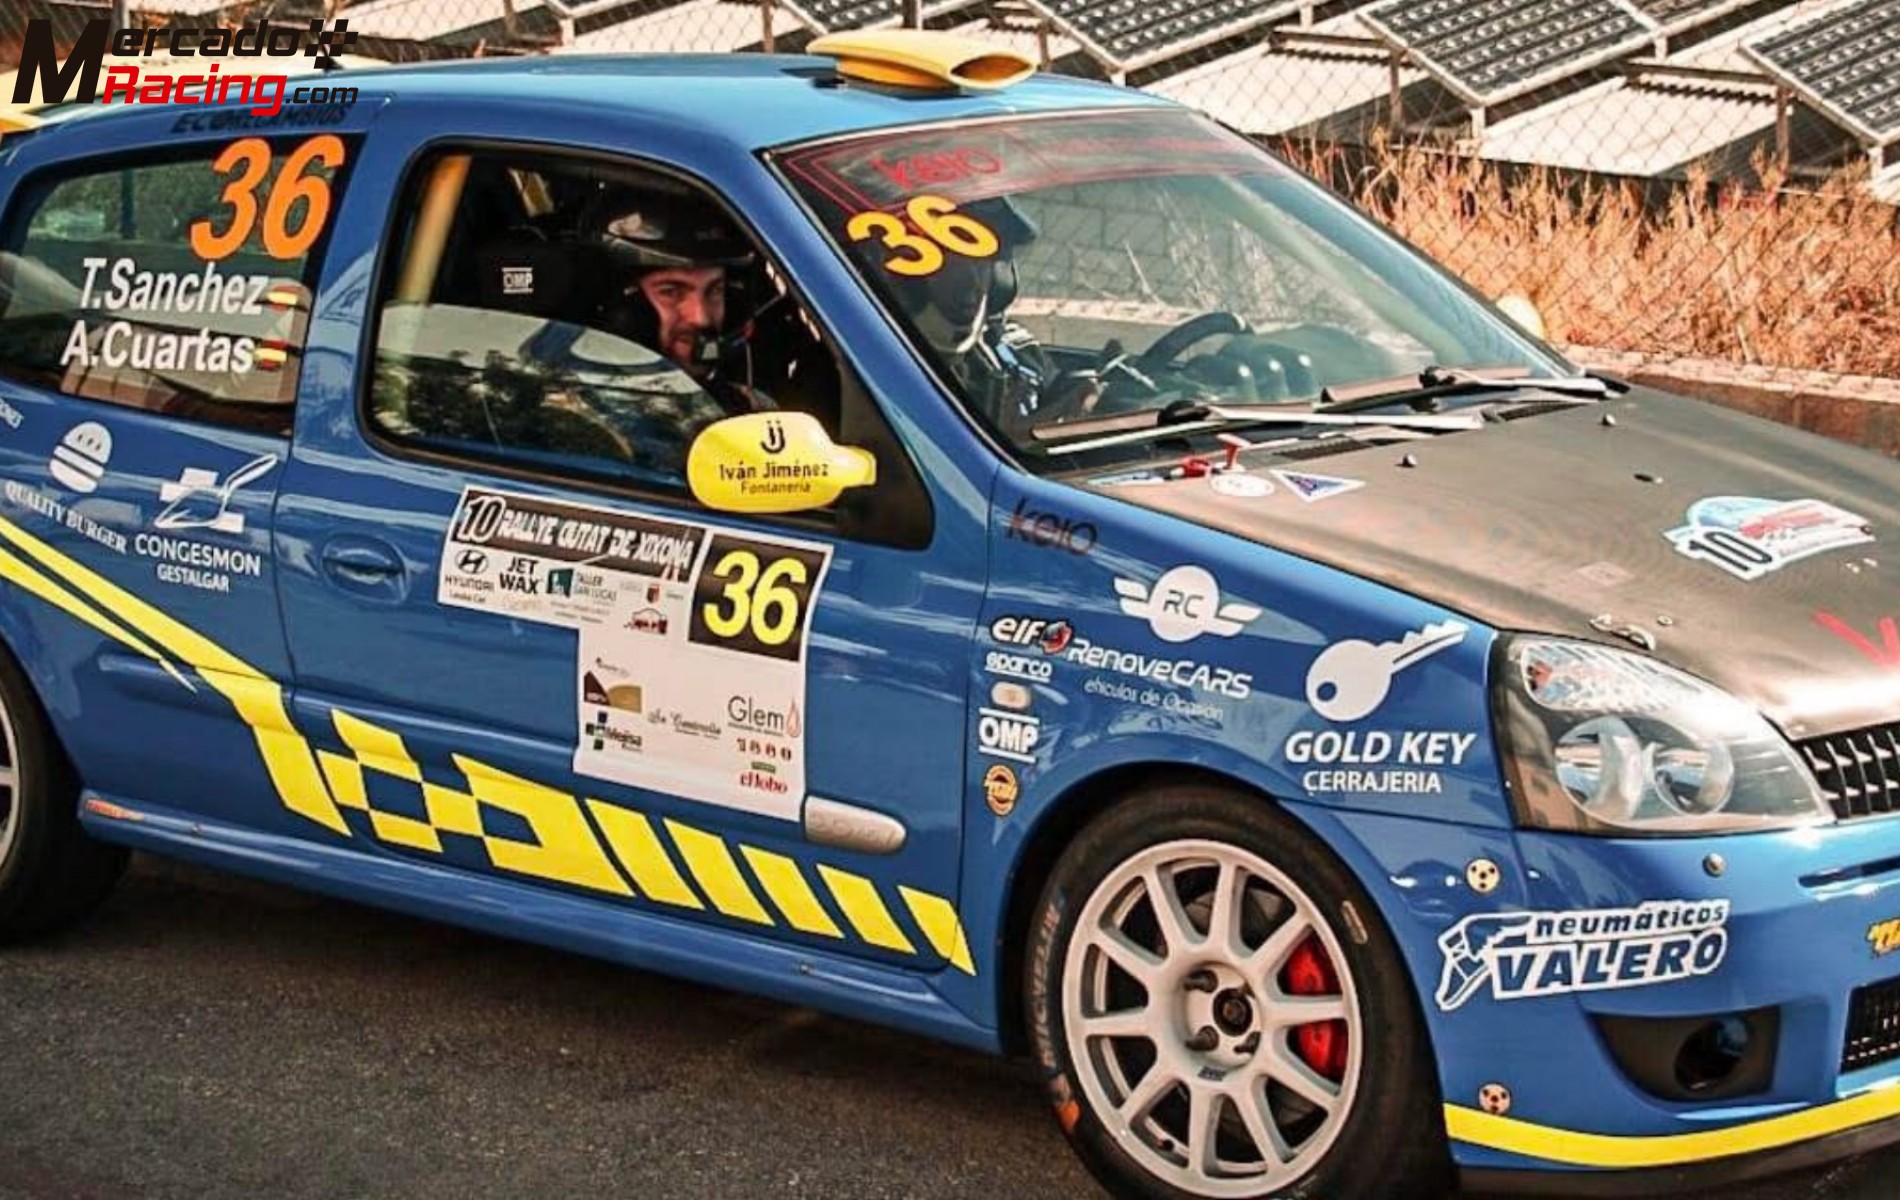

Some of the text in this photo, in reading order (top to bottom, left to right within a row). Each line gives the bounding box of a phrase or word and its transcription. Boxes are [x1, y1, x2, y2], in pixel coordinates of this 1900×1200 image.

[190, 134, 345, 260] 36
[846, 195, 999, 277] 36
[80, 257, 270, 316] T.Sanchez
[503, 272, 534, 289] OMP
[61, 319, 256, 373] A.Cuartas
[720, 459, 829, 481] Iván Jiménez
[5, 480, 127, 554] QUALITY BURGER
[457, 496, 506, 543] 10
[497, 511, 560, 546] RALLYE
[607, 527, 638, 559] DE
[135, 533, 261, 576] CONGESMON
[507, 556, 540, 576] JET
[1689, 531, 1773, 573] 10
[157, 562, 229, 593] GESTALGAR
[445, 574, 495, 593] HYUNDAI
[499, 573, 539, 595] WAX
[701, 549, 807, 646] 36
[1163, 588, 1206, 620] RC
[991, 616, 1047, 646] elf
[728, 694, 785, 731] Glem
[1140, 689, 1160, 706] de
[978, 716, 1040, 754] OMP
[1284, 731, 1477, 765] GOLD KEY
[1302, 770, 1442, 795] CERRAJERIA
[1535, 904, 1724, 937] neumáticos
[1496, 932, 1724, 993] VALERO
